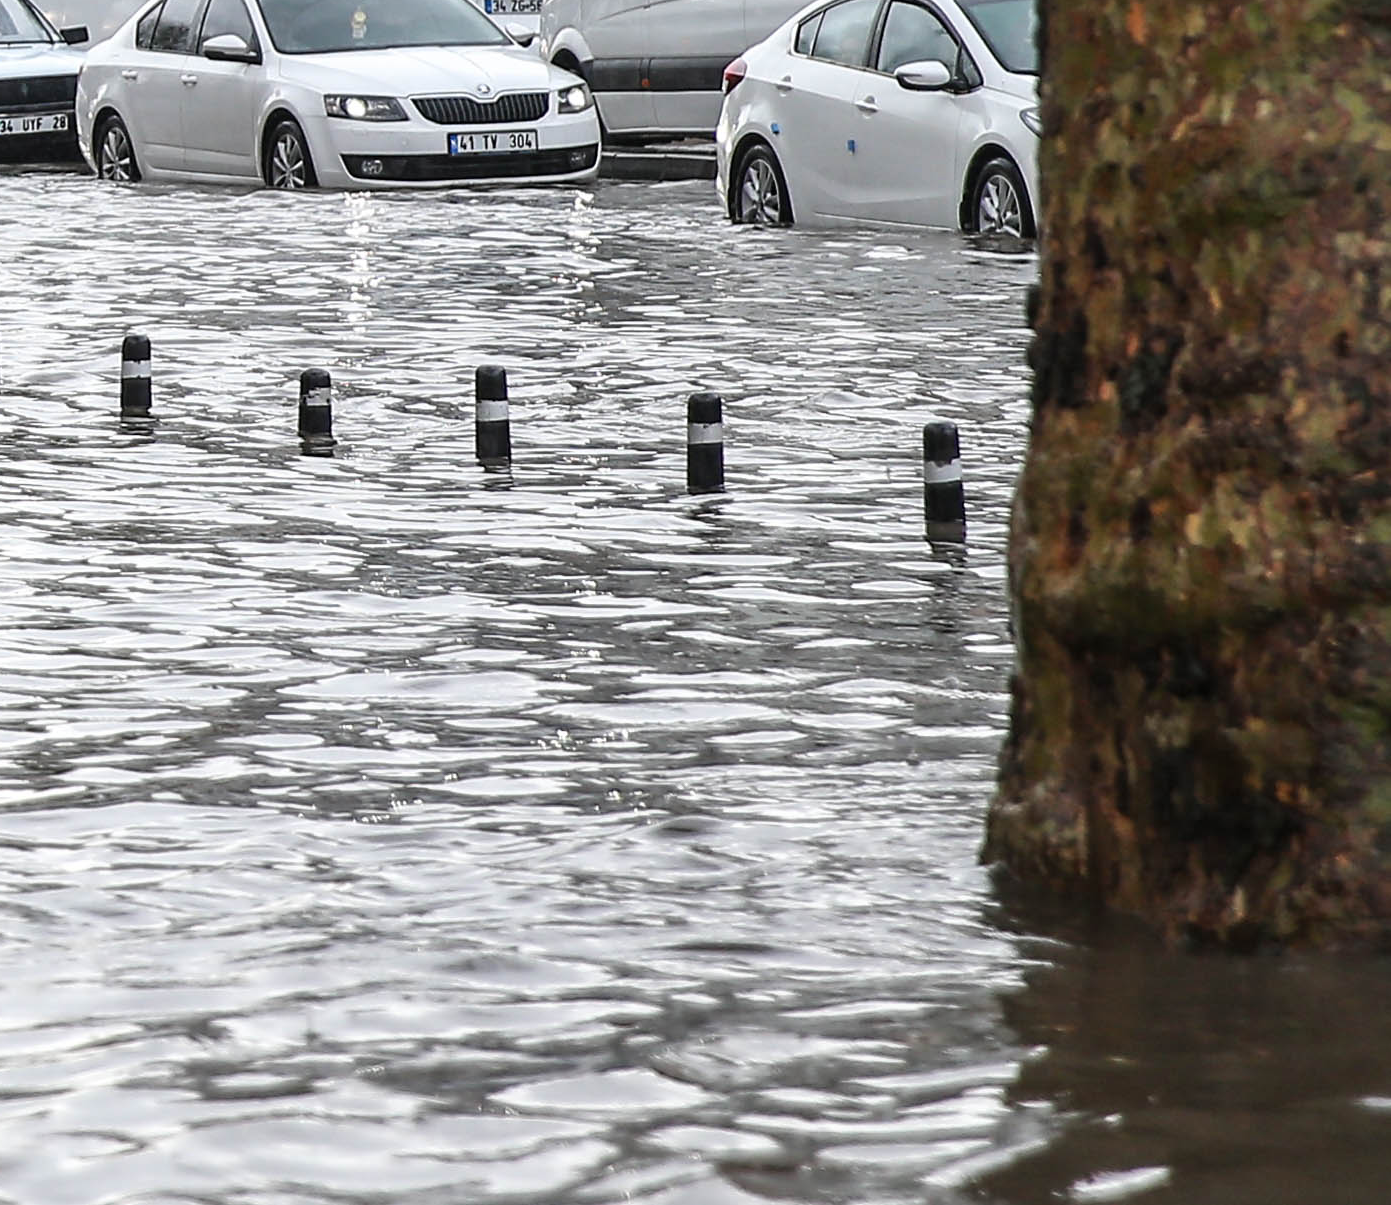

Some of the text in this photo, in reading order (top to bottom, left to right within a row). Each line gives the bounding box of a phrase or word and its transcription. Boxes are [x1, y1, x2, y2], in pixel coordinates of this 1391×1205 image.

[493, 0, 506, 12] 34
[0, 116, 66, 132] 34 UYF 28
[460, 133, 532, 150] 41 TV 304
